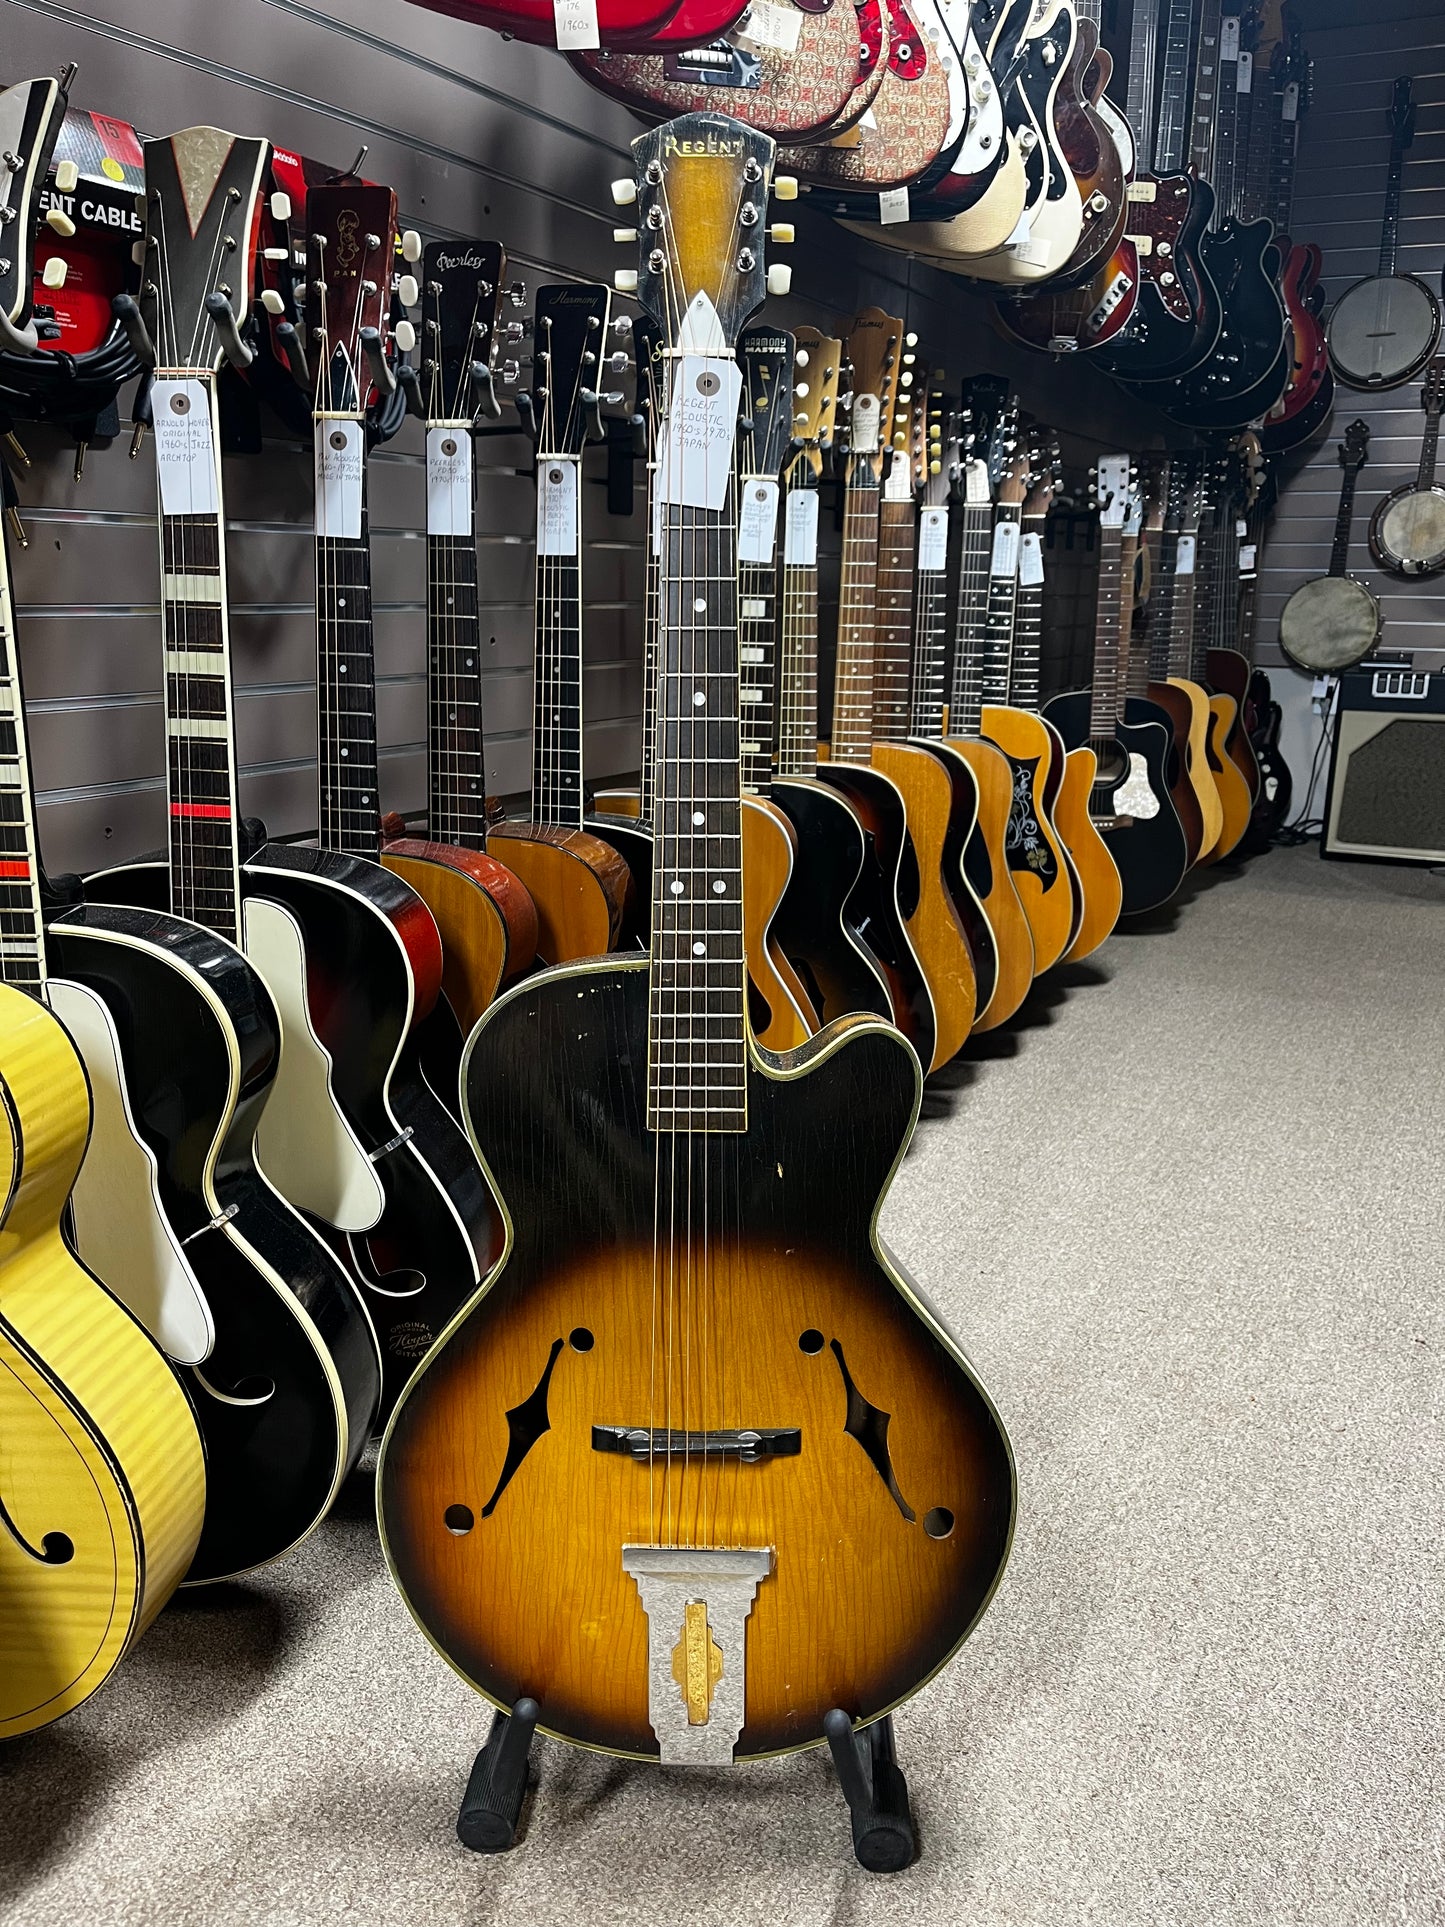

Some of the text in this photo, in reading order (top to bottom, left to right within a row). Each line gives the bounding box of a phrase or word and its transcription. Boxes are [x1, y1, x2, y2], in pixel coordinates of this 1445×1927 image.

[563, 19, 589, 31] 1960s
[665, 135, 744, 158] REGENT
[81, 200, 142, 232] CABLE
[436, 247, 486, 272] Peerless
[549, 290, 599, 308] Harmony
[744, 337, 787, 346] HARMONY
[744, 346, 787, 354] MASTER
[676, 395, 718, 410] REGENT
[675, 411, 723, 426] ACOUSTIC
[162, 429, 201, 437] ORIGINAL
[675, 437, 711, 450] JAPAN
[390, 1321, 431, 1334] ORIGINAL
